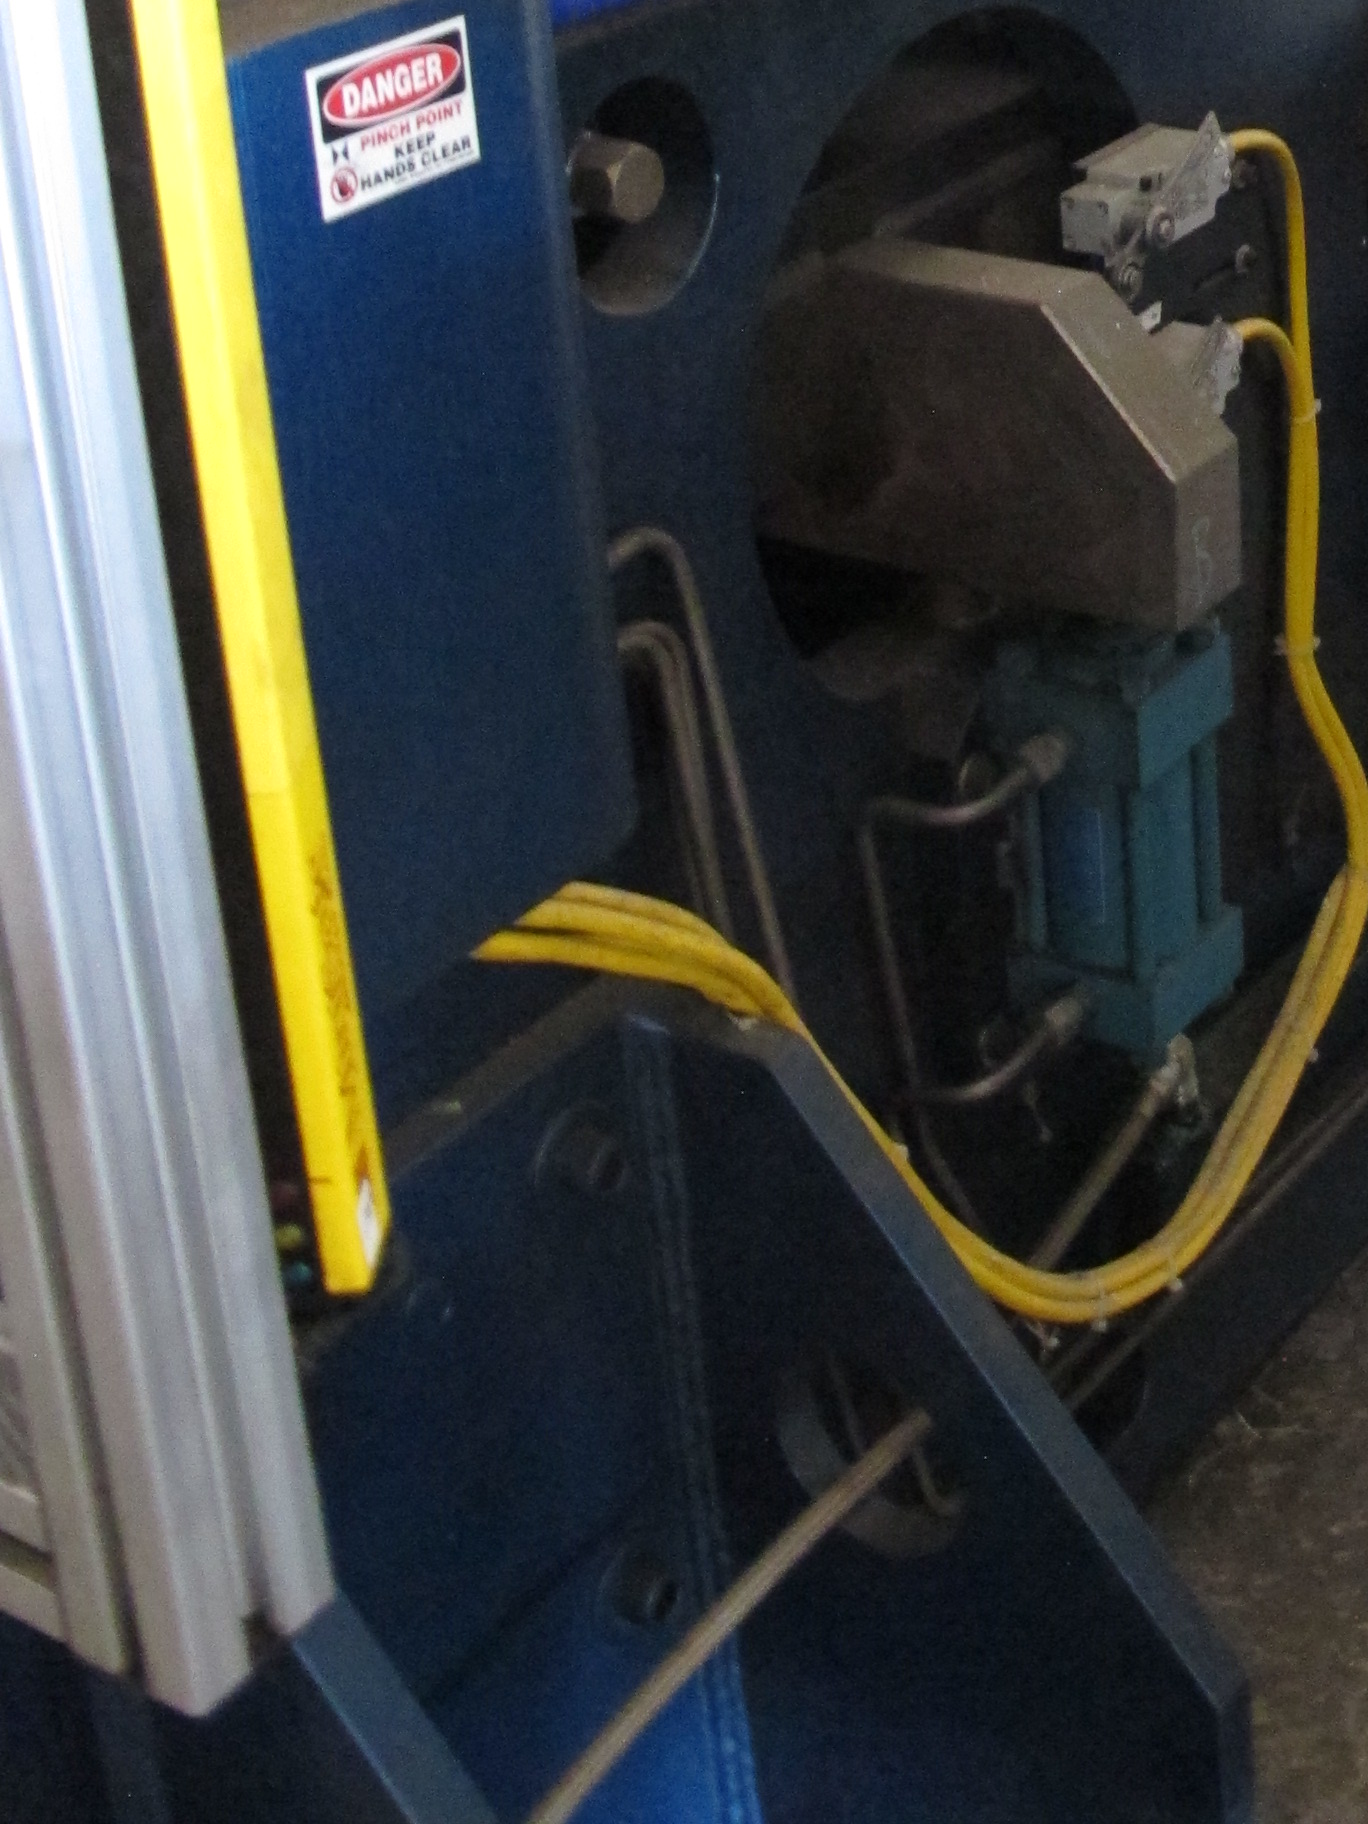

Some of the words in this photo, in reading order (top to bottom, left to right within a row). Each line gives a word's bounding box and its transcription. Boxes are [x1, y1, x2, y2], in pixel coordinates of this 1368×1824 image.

[341, 52, 444, 119] DANGER
[360, 120, 411, 152] PINCH
[415, 100, 463, 129] POINT
[394, 130, 436, 158] KEEP
[360, 156, 416, 191] HANDS
[421, 135, 472, 169] CLEAR
